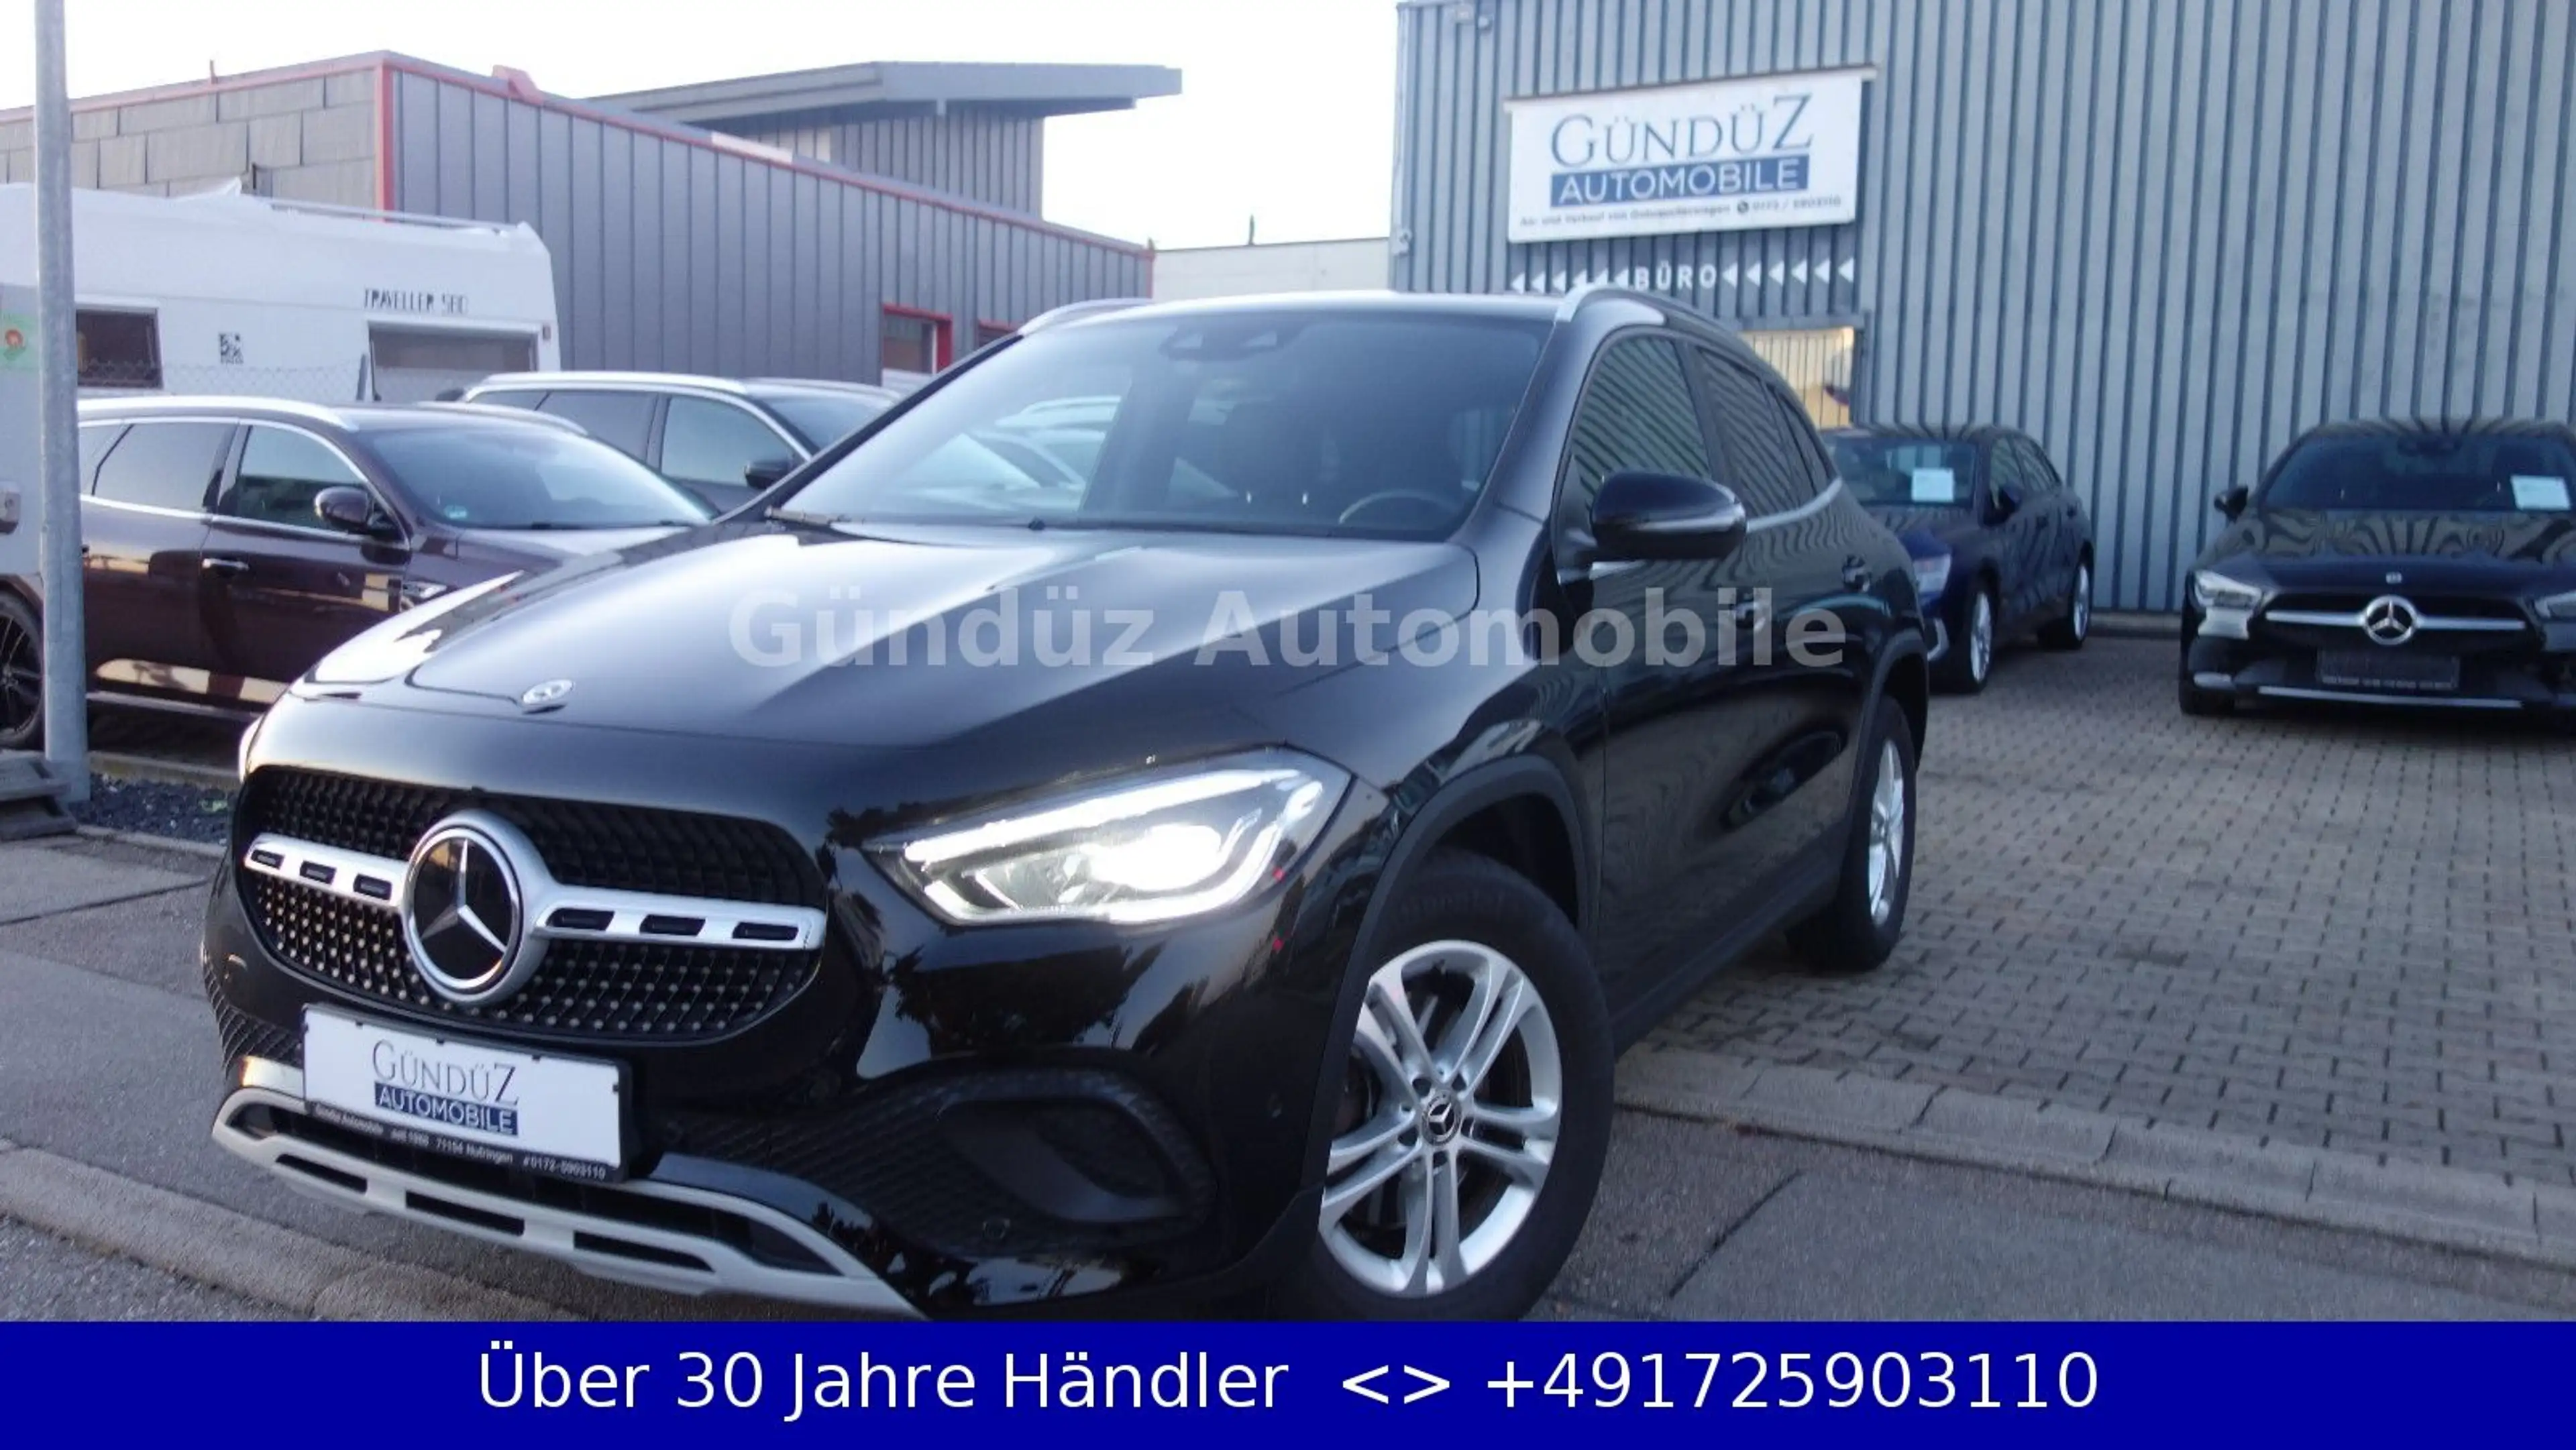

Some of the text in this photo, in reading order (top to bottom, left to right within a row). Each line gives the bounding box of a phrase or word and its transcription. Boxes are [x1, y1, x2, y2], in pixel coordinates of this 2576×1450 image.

[1551, 93, 1814, 168] GÜNDÜZ
[1558, 158, 1801, 203] AUTOMOBILE
[1634, 260, 1717, 291] BÜRO
[373, 1039, 519, 1105] GÜNDÜZ
[379, 1086, 514, 1134] AUTOMOBILE
